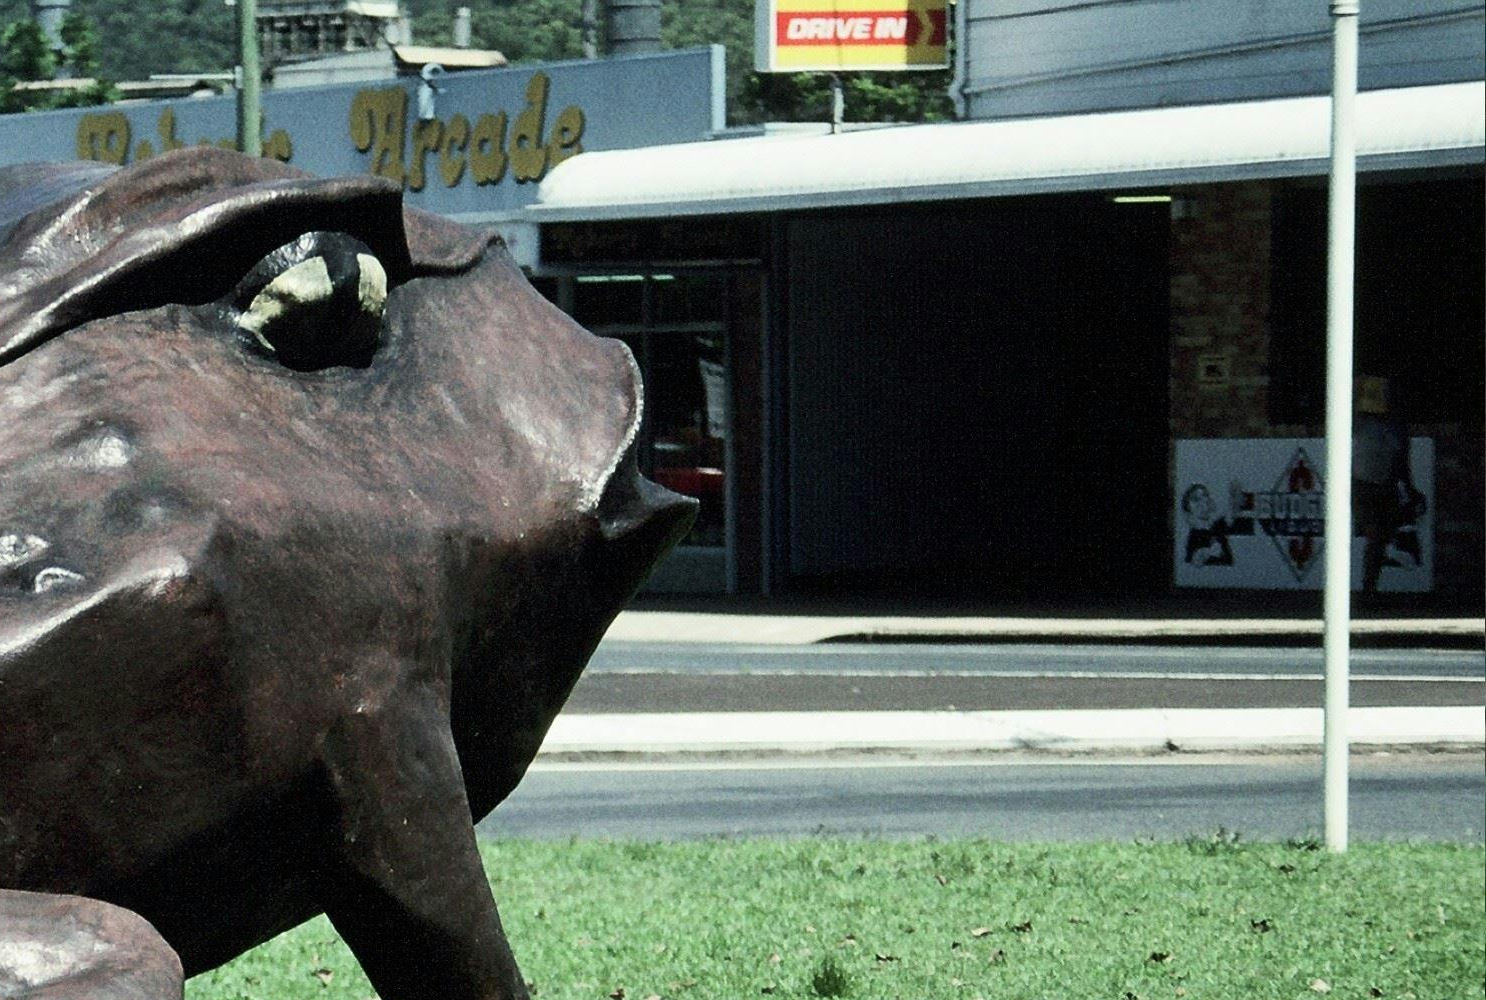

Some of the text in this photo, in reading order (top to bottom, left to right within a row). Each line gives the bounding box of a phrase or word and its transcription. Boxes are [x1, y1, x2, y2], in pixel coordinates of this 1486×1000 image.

[786, 17, 908, 40] DRIVE IN
[349, 69, 585, 192] Arcade
